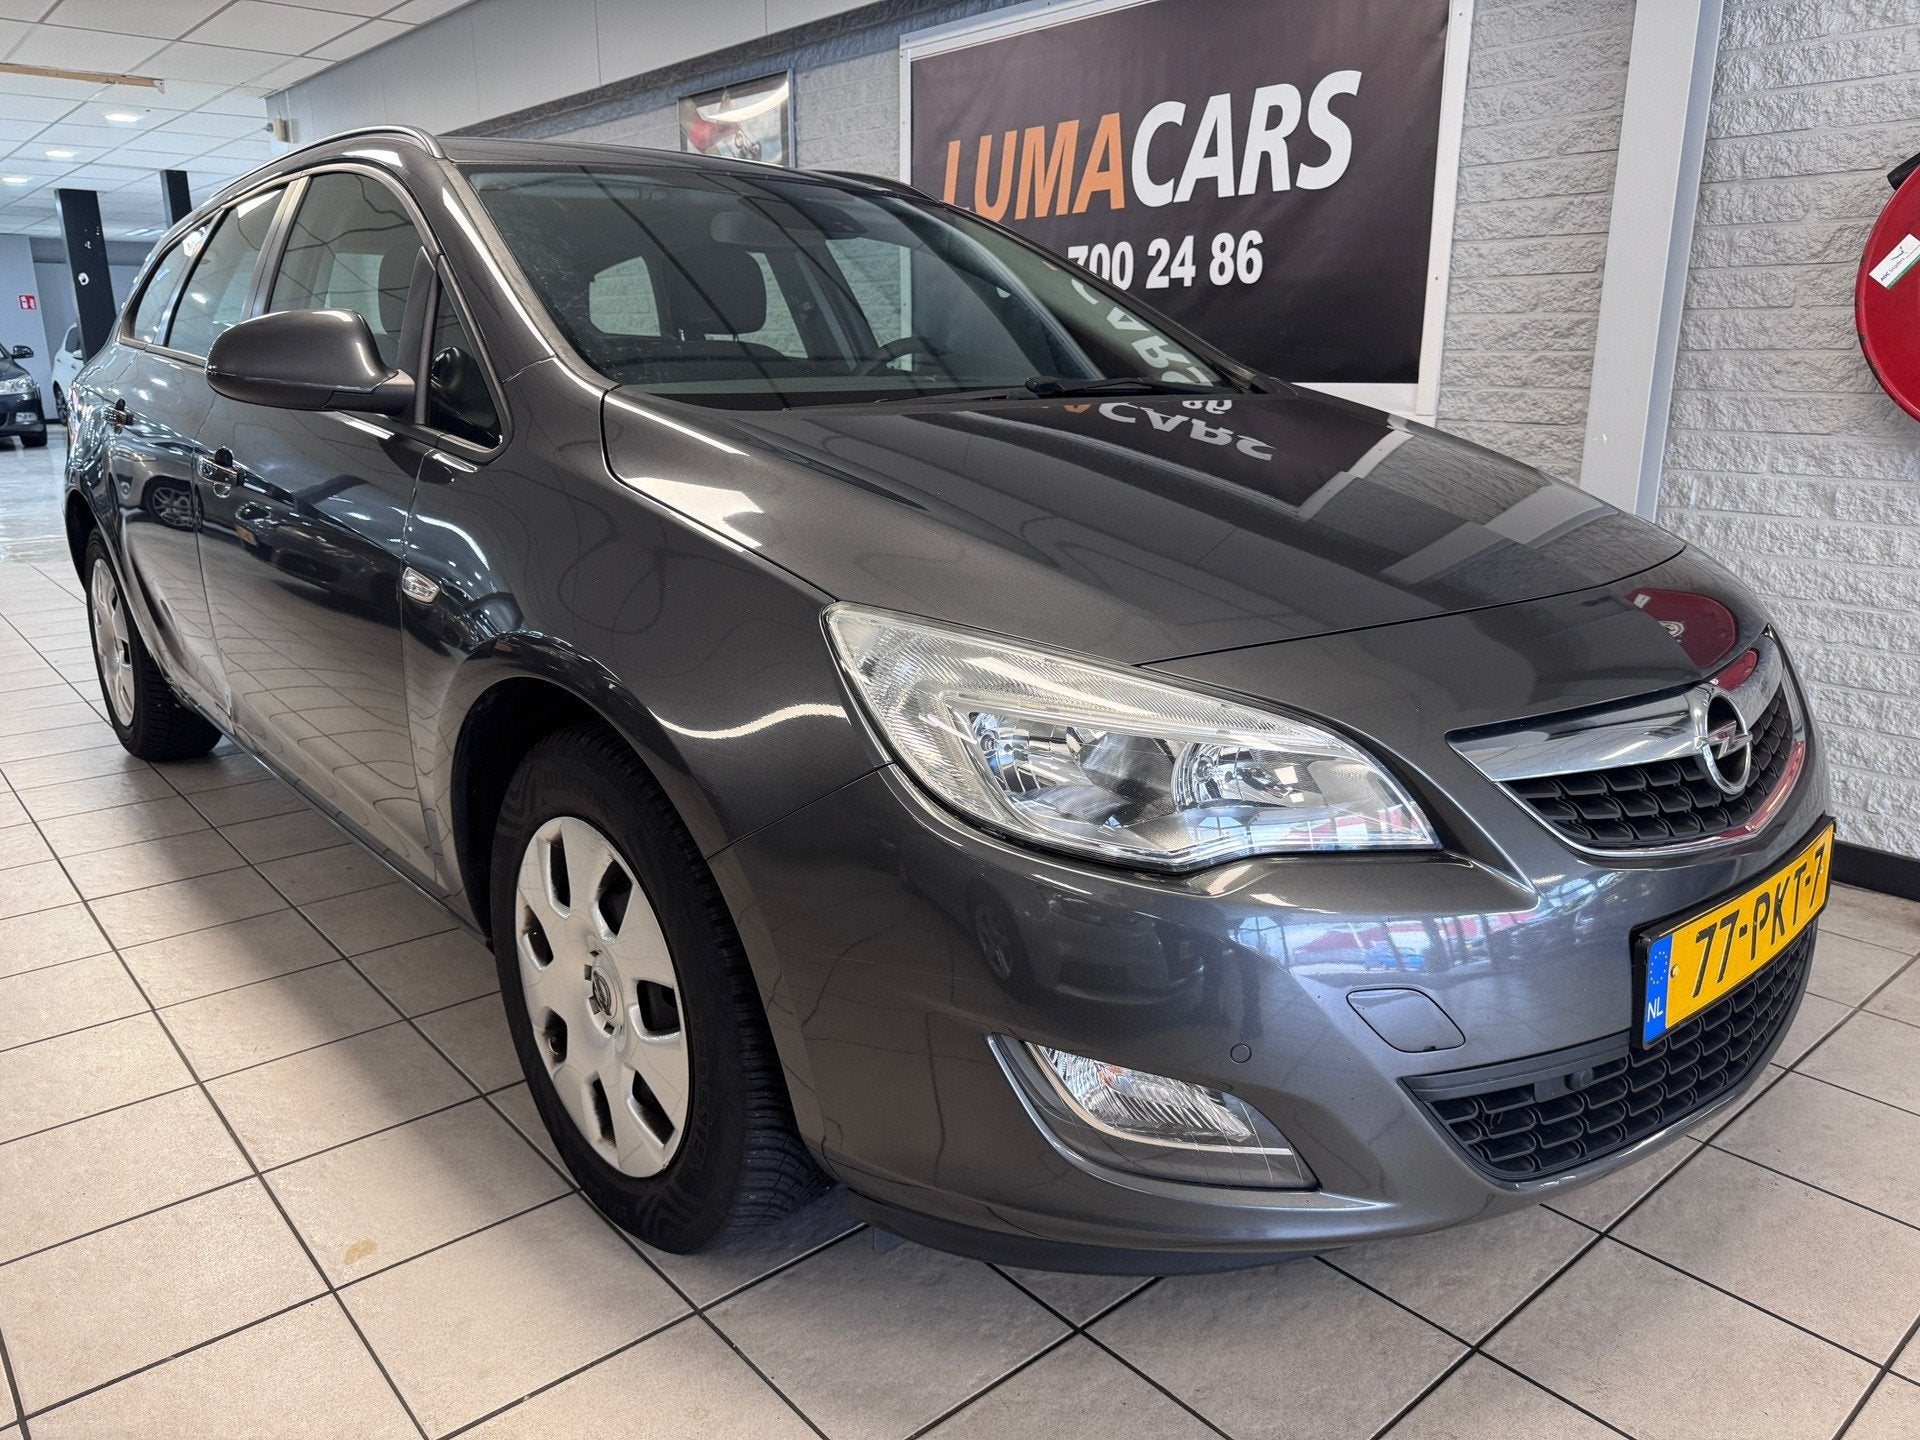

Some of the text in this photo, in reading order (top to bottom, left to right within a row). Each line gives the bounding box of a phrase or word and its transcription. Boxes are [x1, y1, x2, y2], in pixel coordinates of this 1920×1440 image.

[943, 70, 1362, 222] LUMACARS
[1145, 236, 1196, 289] 24
[1209, 230, 1264, 286] 86
[1692, 843, 1825, 998] 77-PKT-7
[1646, 996, 1664, 1023] NL
